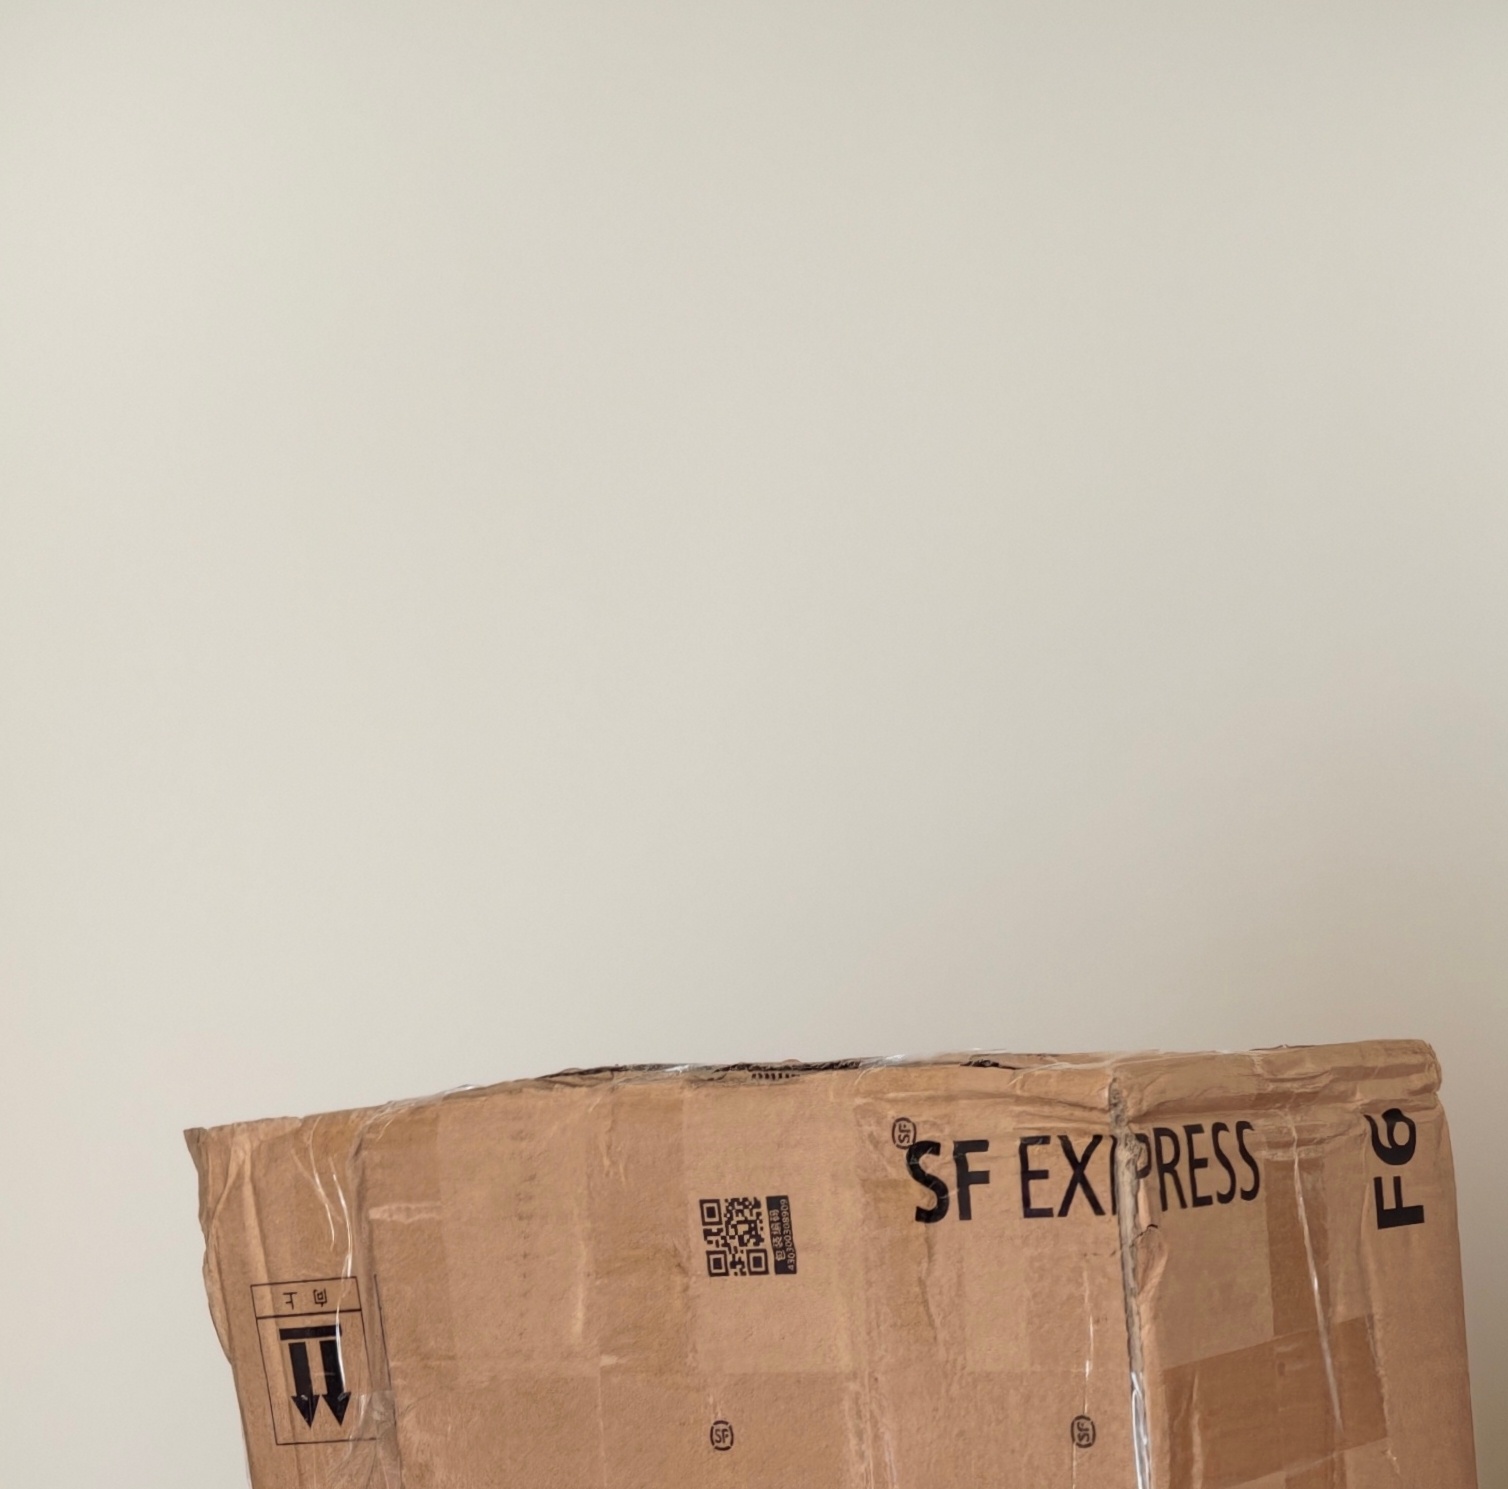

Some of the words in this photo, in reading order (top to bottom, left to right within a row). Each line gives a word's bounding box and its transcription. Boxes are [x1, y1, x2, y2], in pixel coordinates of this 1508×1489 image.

[904, 1137, 990, 1224] SF
[1019, 1119, 1260, 1220] EXPRESS
[1368, 1107, 1425, 1230] F6
